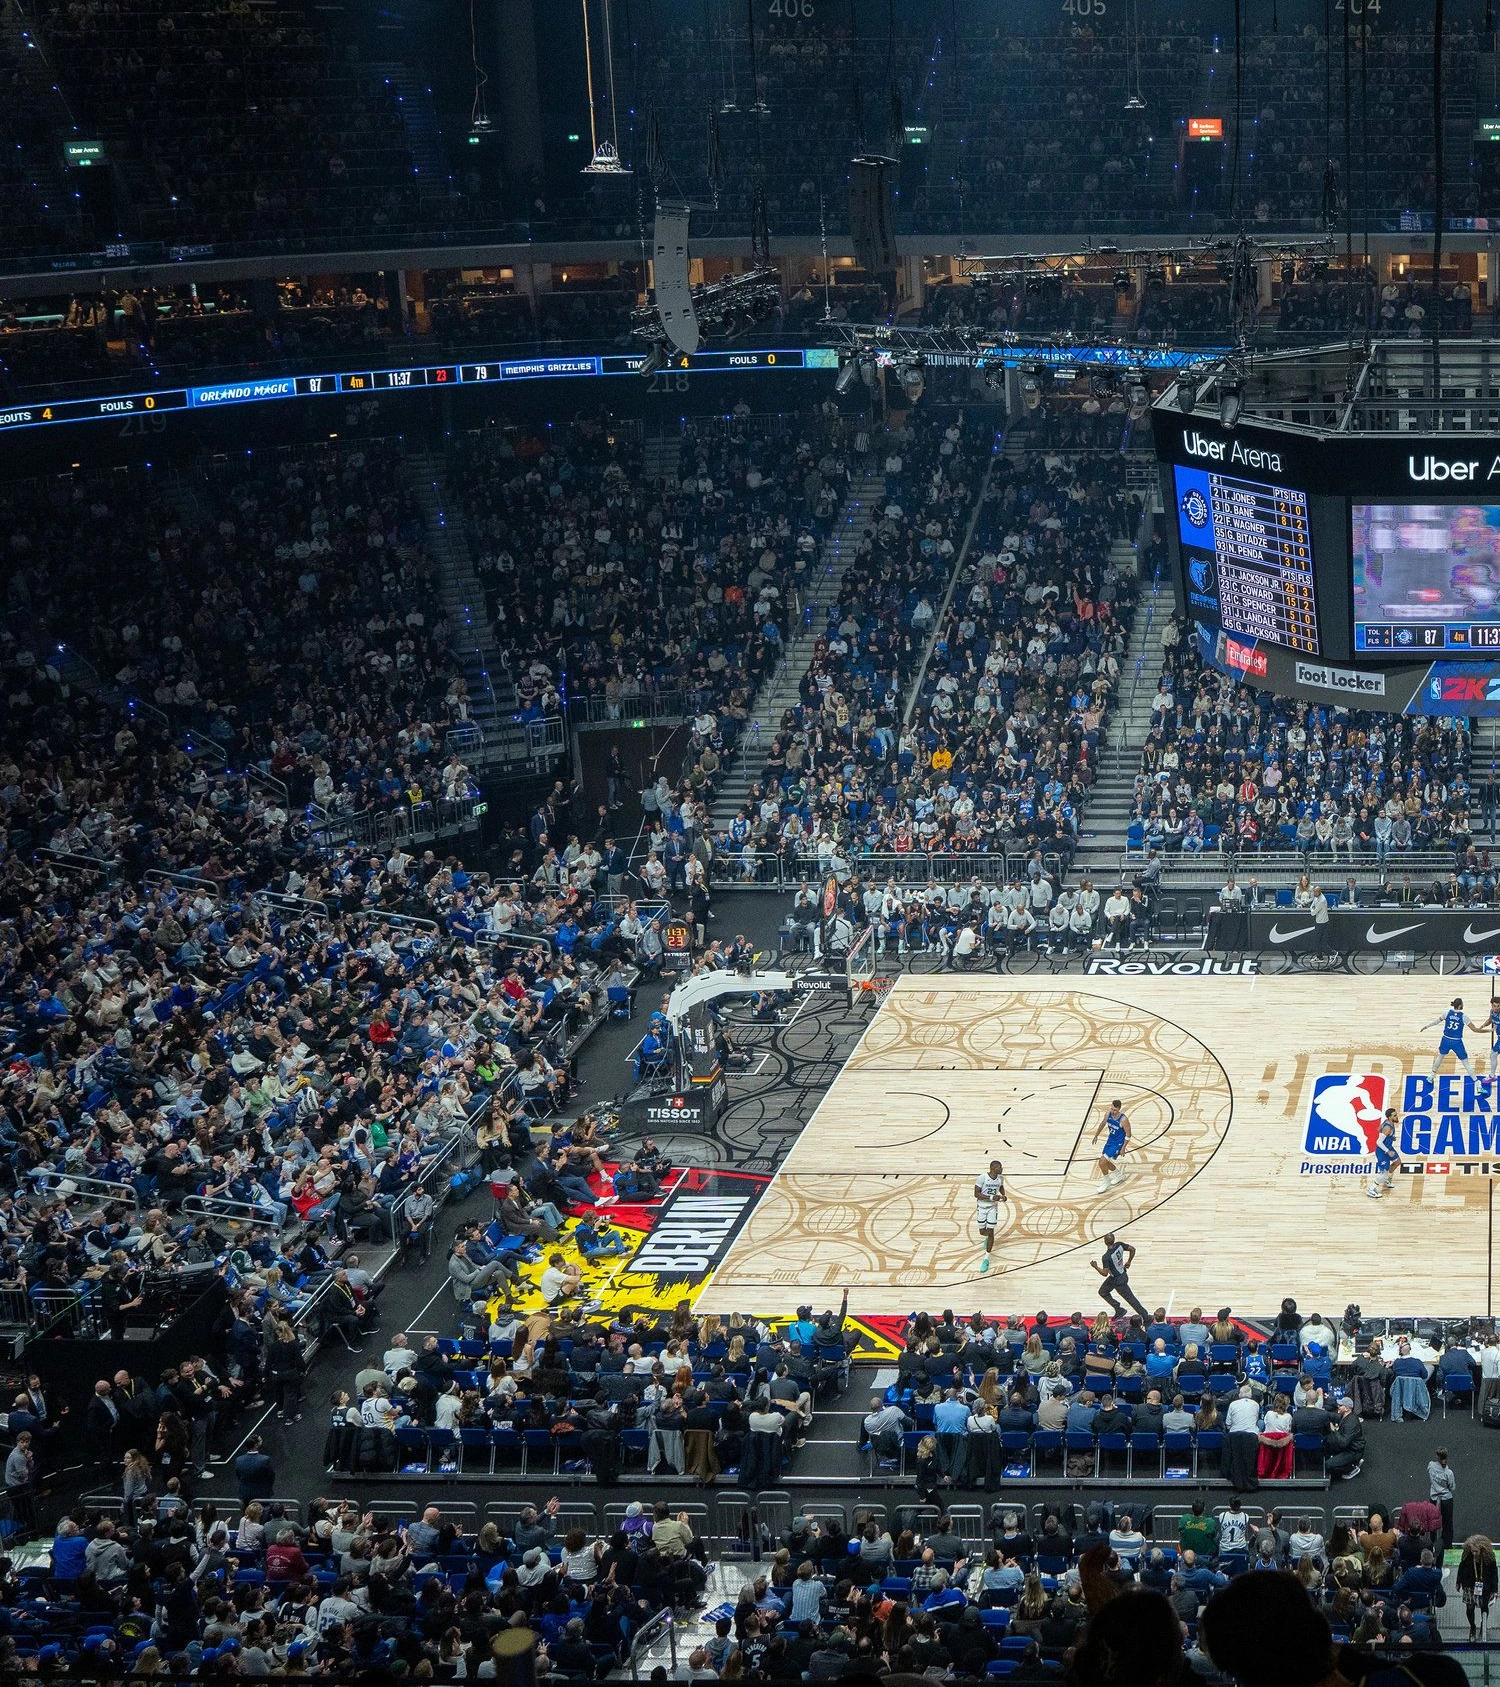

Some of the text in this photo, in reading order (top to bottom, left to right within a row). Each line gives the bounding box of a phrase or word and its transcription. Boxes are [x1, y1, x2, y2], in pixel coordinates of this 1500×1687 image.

[768, 0, 814, 18] 406
[1062, 0, 1106, 16] 405
[626, 353, 776, 369] TIMS 4 FOULS 0
[200, 362, 592, 402] ORLANDO MAGIC 87 4TH 11:37 23 79 MEMPHIS GRIZZLIES
[646, 373, 690, 393] 218
[0, 396, 155, 424] EOUTS 4 FOULS 0
[119, 411, 167, 437] 219
[1183, 430, 1282, 472] Uber Arena
[1409, 456, 1479, 480] Uber
[1213, 488, 1256, 506] 2 T. JONES
[1275, 489, 1304, 503] PTS FLS
[1214, 501, 1255, 519] 3 D. BANE
[1214, 514, 1265, 534] 22 F. WAGNER
[1215, 527, 1268, 549] 35 G. BITADZE
[1216, 541, 1264, 561] 93 N. PENDA
[1424, 629, 1437, 645] 87
[1453, 631, 1465, 642] 4TH
[1229, 645, 1263, 670] Emirates
[1299, 666, 1382, 691] Foot Locker
[666, 928, 687, 936] 11:37
[668, 936, 684, 947] 23
[1087, 958, 1258, 975] Revolut
[797, 980, 831, 989] Revolut
[1447, 1020, 1459, 1030] 35
[647, 1108, 700, 1119] TISSOT
[1313, 1136, 1351, 1151] NBA
[1300, 1161, 1374, 1175] Presented
[628, 1196, 750, 1271] BERLIN
[363, 1412, 374, 1425] 30
[752, 1655, 760, 1668] 5
